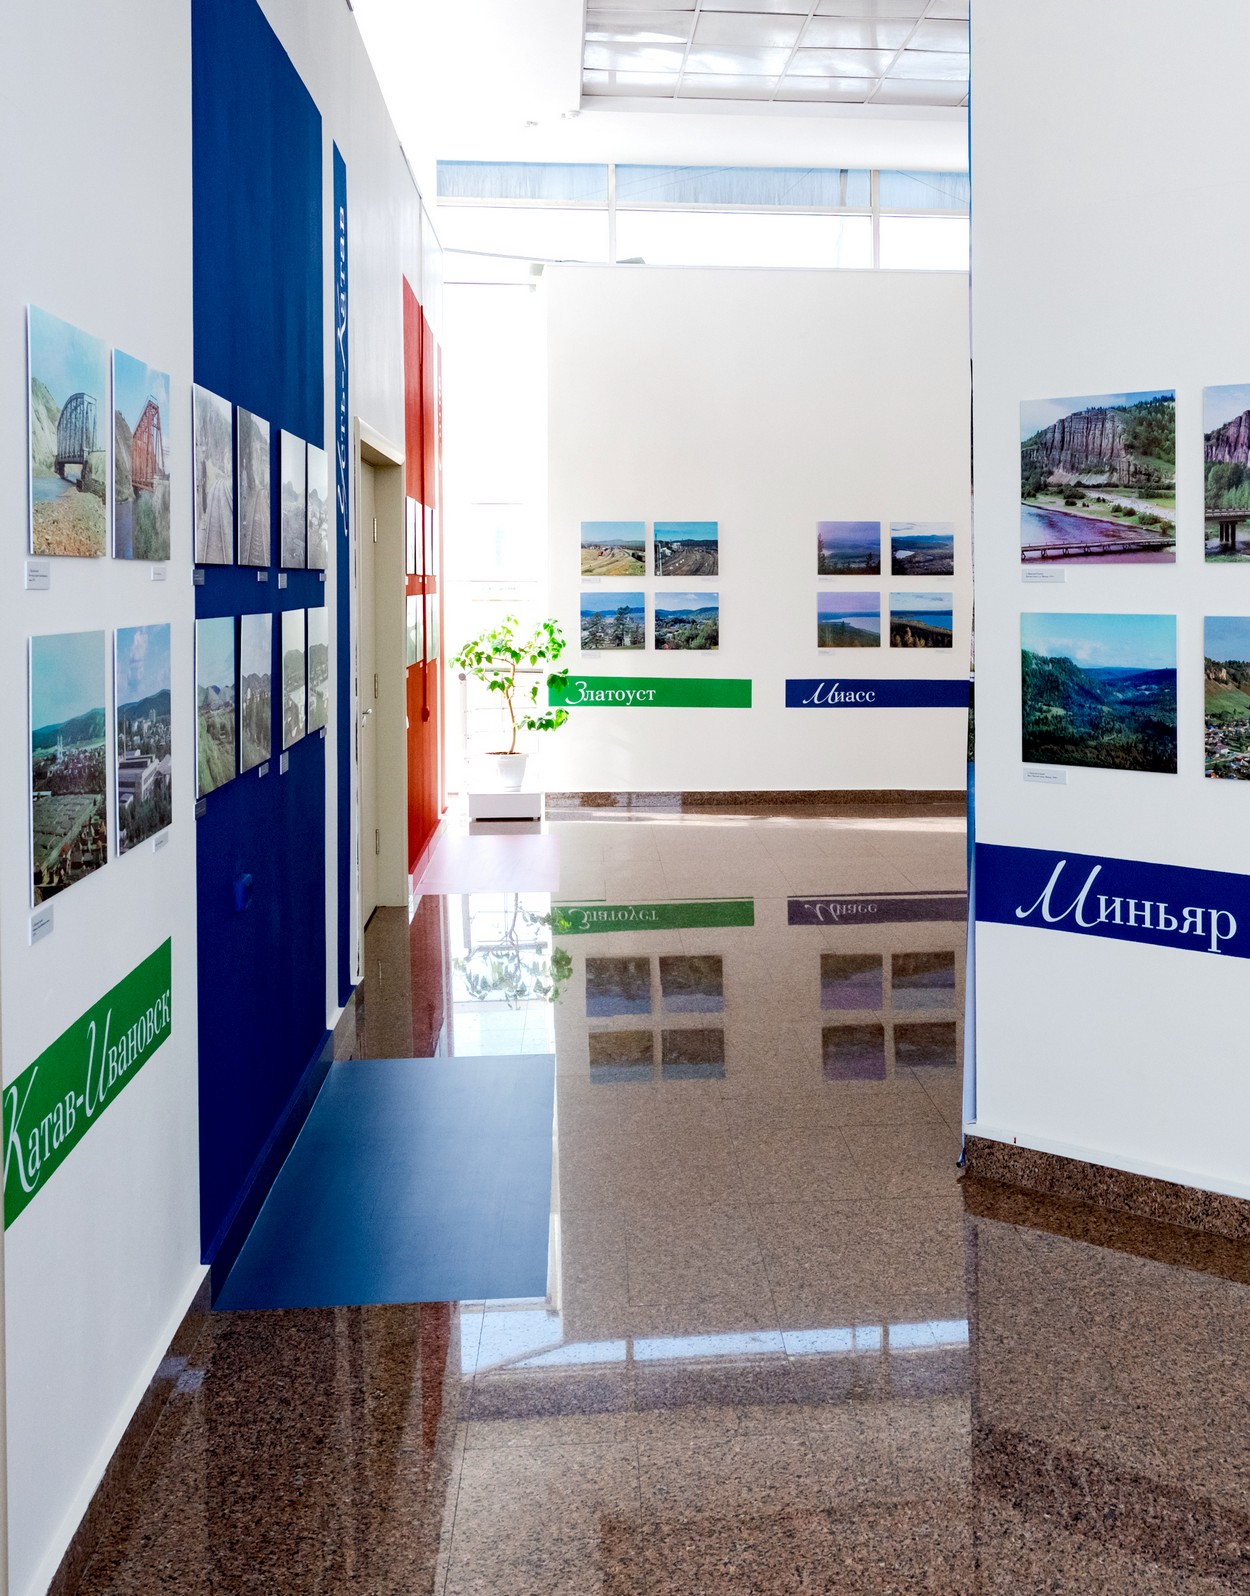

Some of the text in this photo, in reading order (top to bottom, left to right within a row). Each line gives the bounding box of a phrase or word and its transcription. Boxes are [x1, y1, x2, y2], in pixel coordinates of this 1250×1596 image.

[337, 206, 348, 536] Усть-Катав
[565, 681, 656, 705] Златоуст
[802, 682, 876, 704] Миасс
[1015, 859, 1238, 953] Миньяр
[4, 989, 171, 1193] Катав-Ивановск
